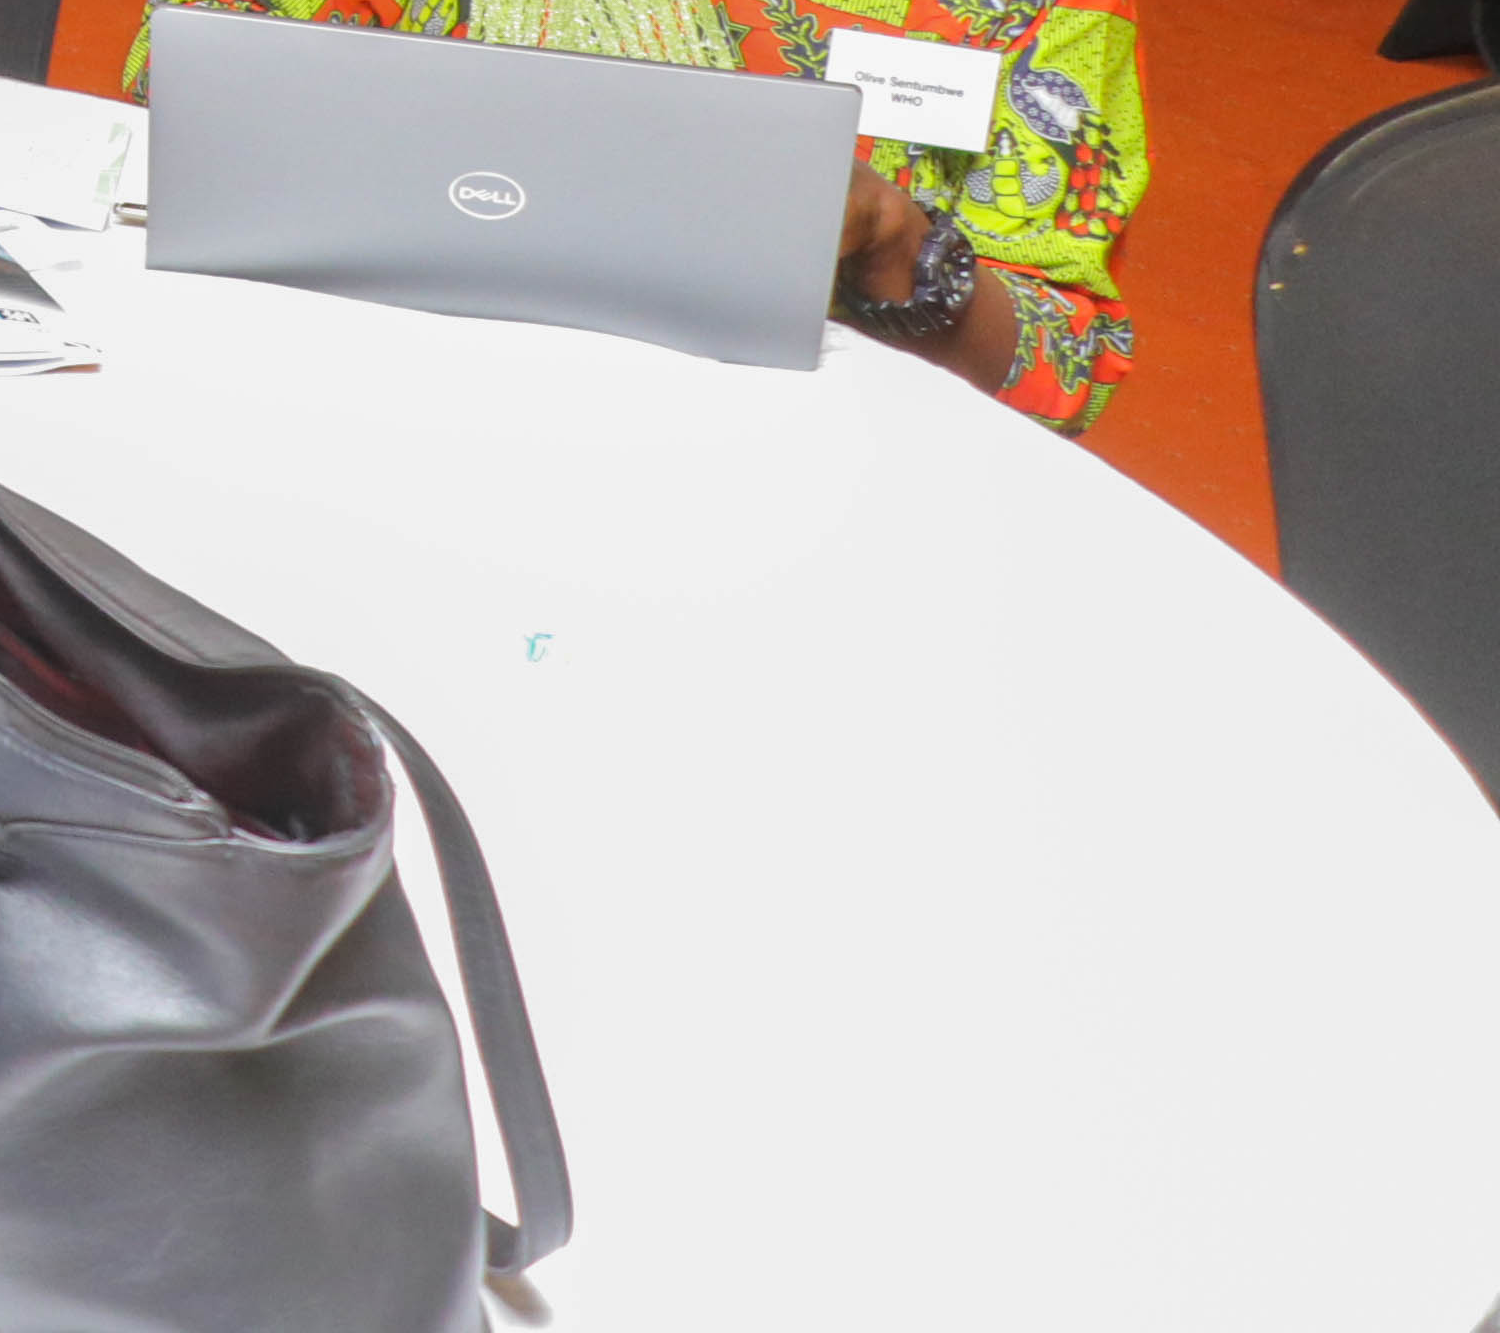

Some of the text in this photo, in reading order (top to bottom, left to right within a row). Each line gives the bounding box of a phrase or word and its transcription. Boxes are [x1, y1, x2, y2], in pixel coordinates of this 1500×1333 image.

[854, 71, 965, 98] Olive Sentumbwe
[891, 92, 924, 107] WHO
[458, 186, 517, 206] DELL
